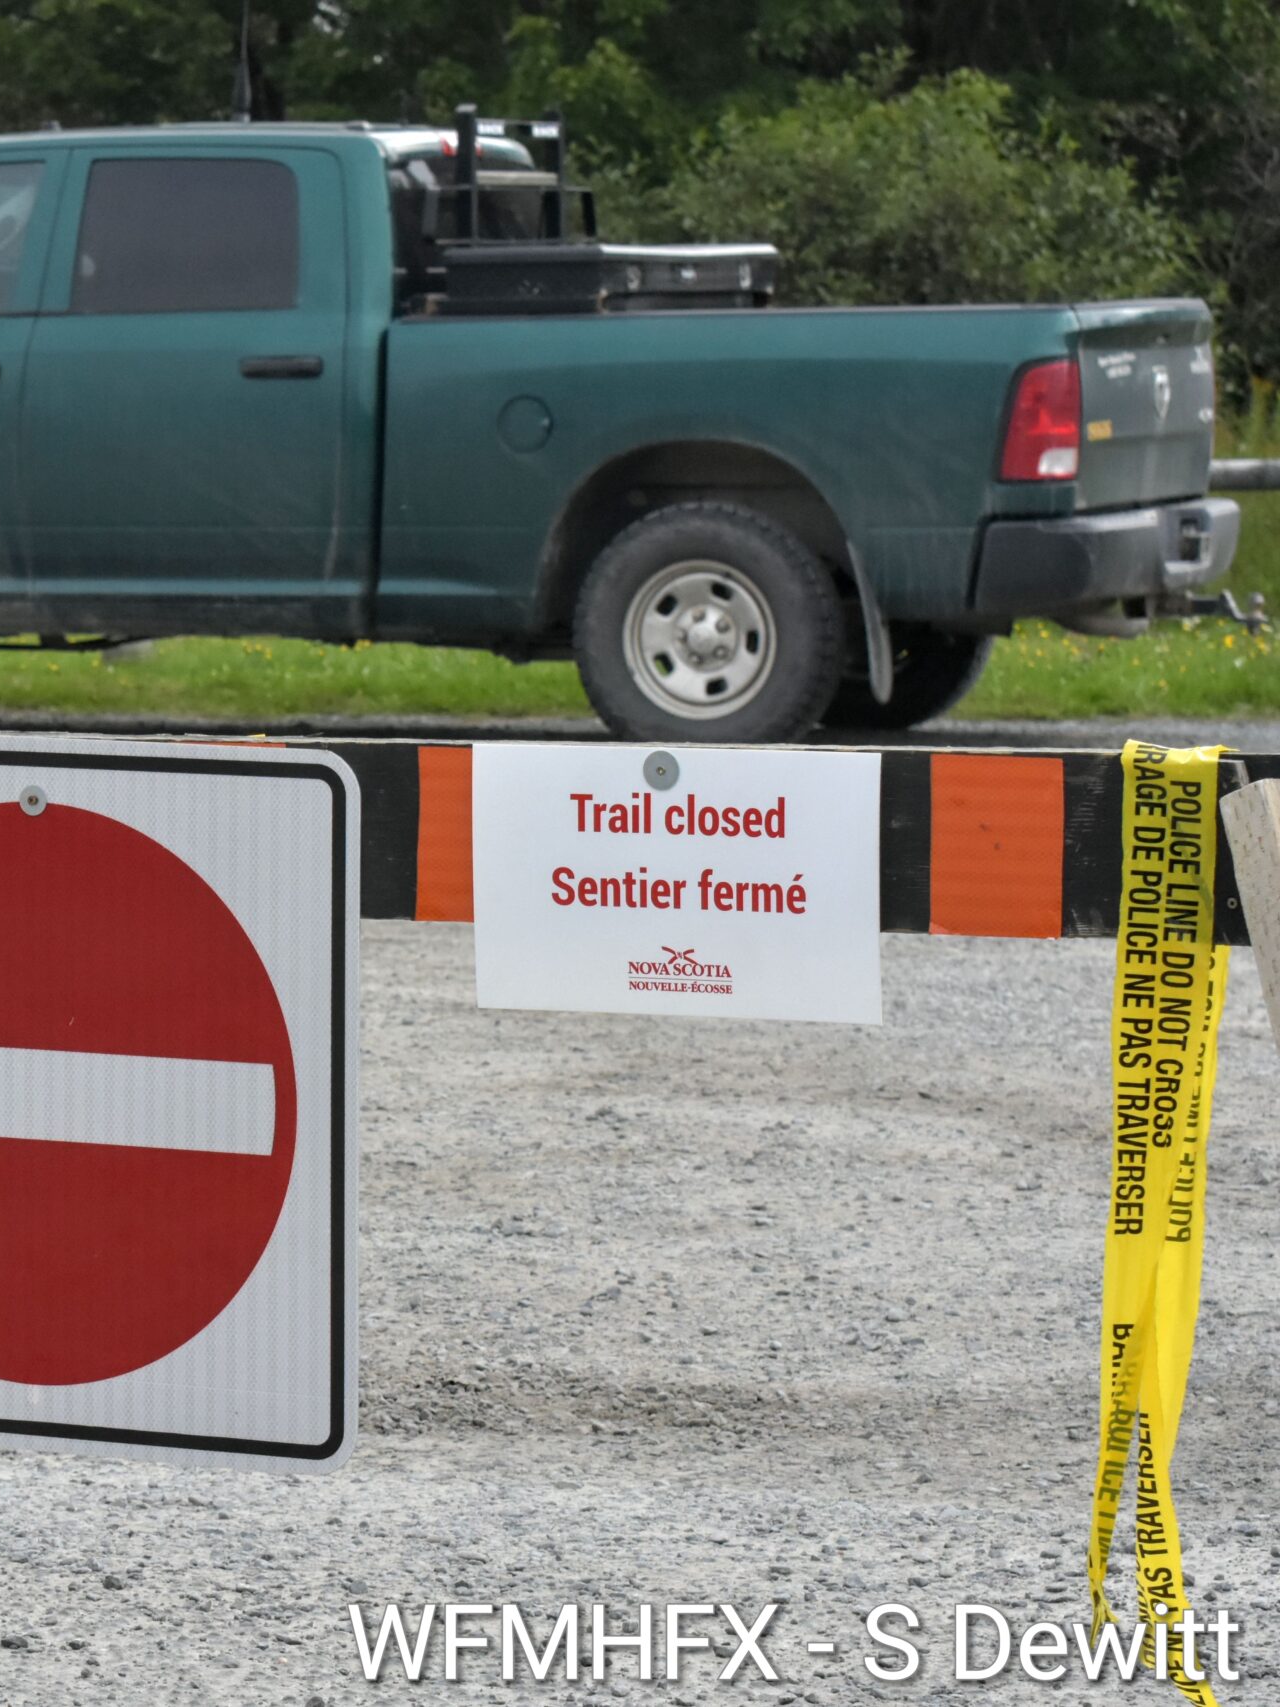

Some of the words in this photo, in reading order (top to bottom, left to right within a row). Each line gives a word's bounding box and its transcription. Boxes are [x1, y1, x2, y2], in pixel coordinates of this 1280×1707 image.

[569, 792, 652, 834] Trail
[664, 794, 786, 839] closed
[1168, 780, 1202, 876] POLICE
[1131, 826, 1166, 862] DE
[551, 866, 687, 910] Sentier
[698, 869, 807, 915] fermé
[1163, 883, 1200, 943] LINE
[1125, 869, 1163, 965] POLICE
[628, 961, 670, 976] NOVA
[673, 963, 732, 978] SCOTIA
[628, 980, 733, 995] NOUVELLE-ÉCOSSE
[1122, 973, 1155, 1009] NE
[1160, 951, 1195, 989] DO
[1118, 1017, 1153, 1069] PAS
[1157, 997, 1192, 1052] NOT
[1114, 1081, 1150, 1236] TRAVERSER
